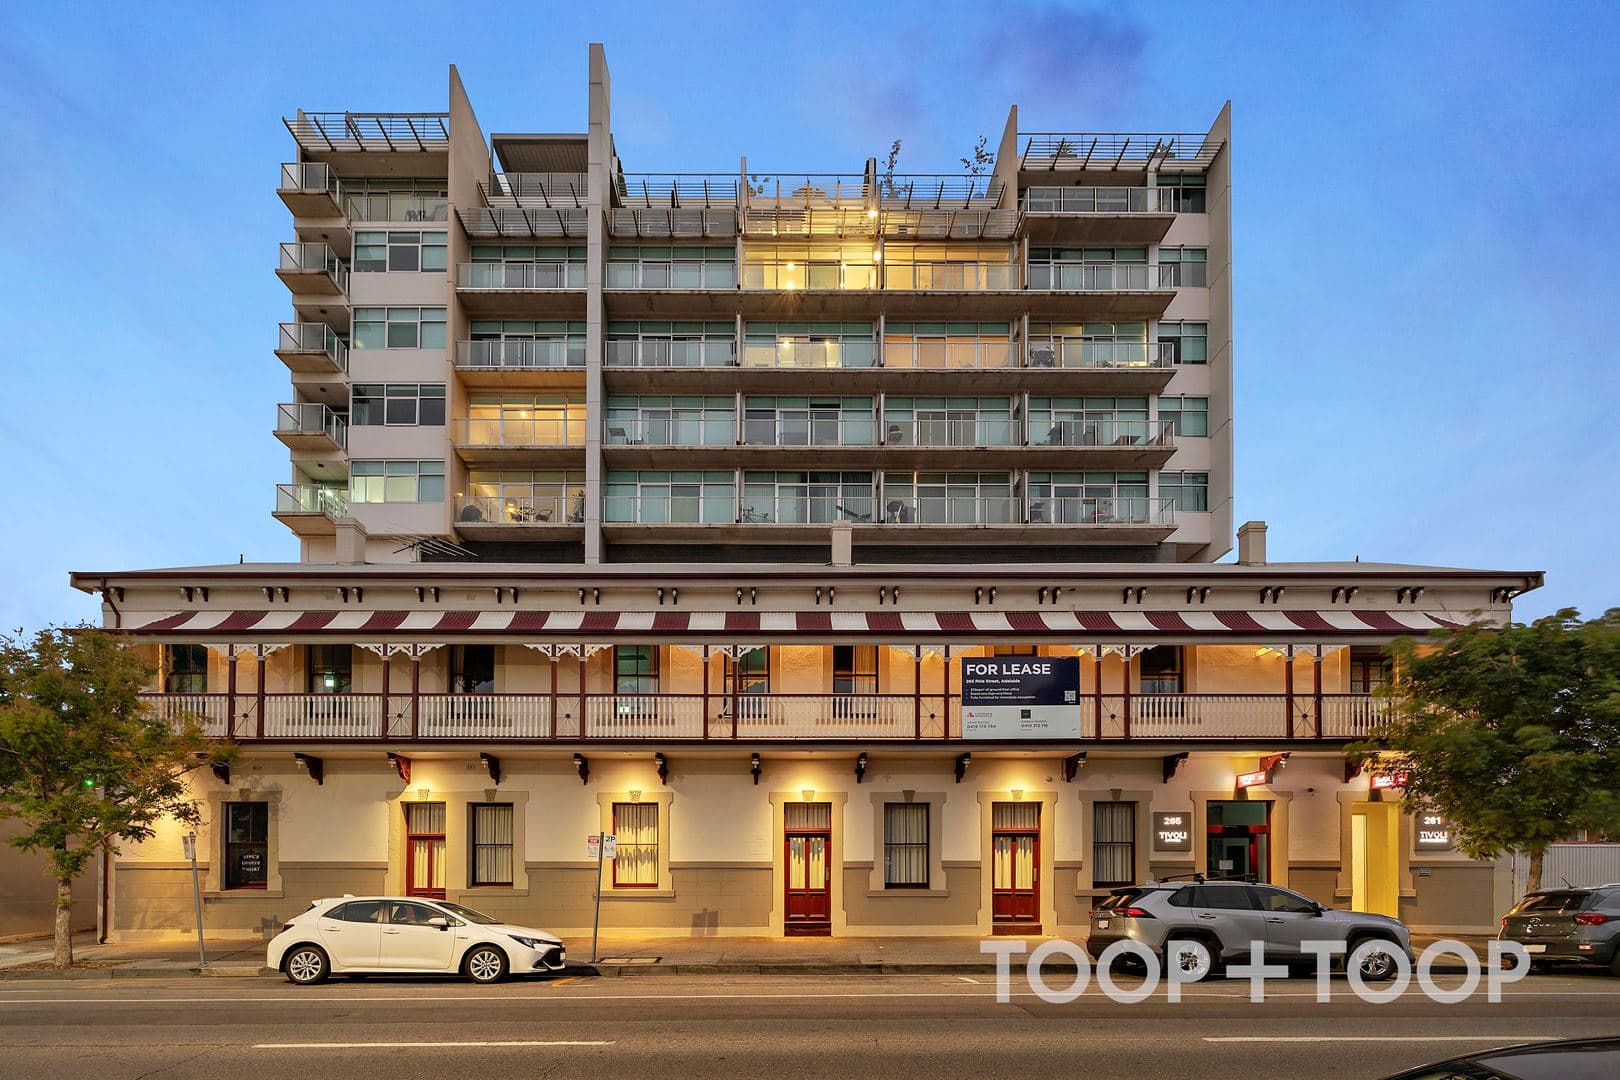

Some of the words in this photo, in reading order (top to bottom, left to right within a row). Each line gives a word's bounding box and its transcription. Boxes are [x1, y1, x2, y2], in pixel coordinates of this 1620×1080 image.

[966, 664, 998, 675] FOR
[1002, 664, 1051, 675] LEASE
[605, 835, 616, 843] 2P
[1158, 831, 1187, 840] TIVOLI
[1419, 831, 1448, 839] TIVOLI
